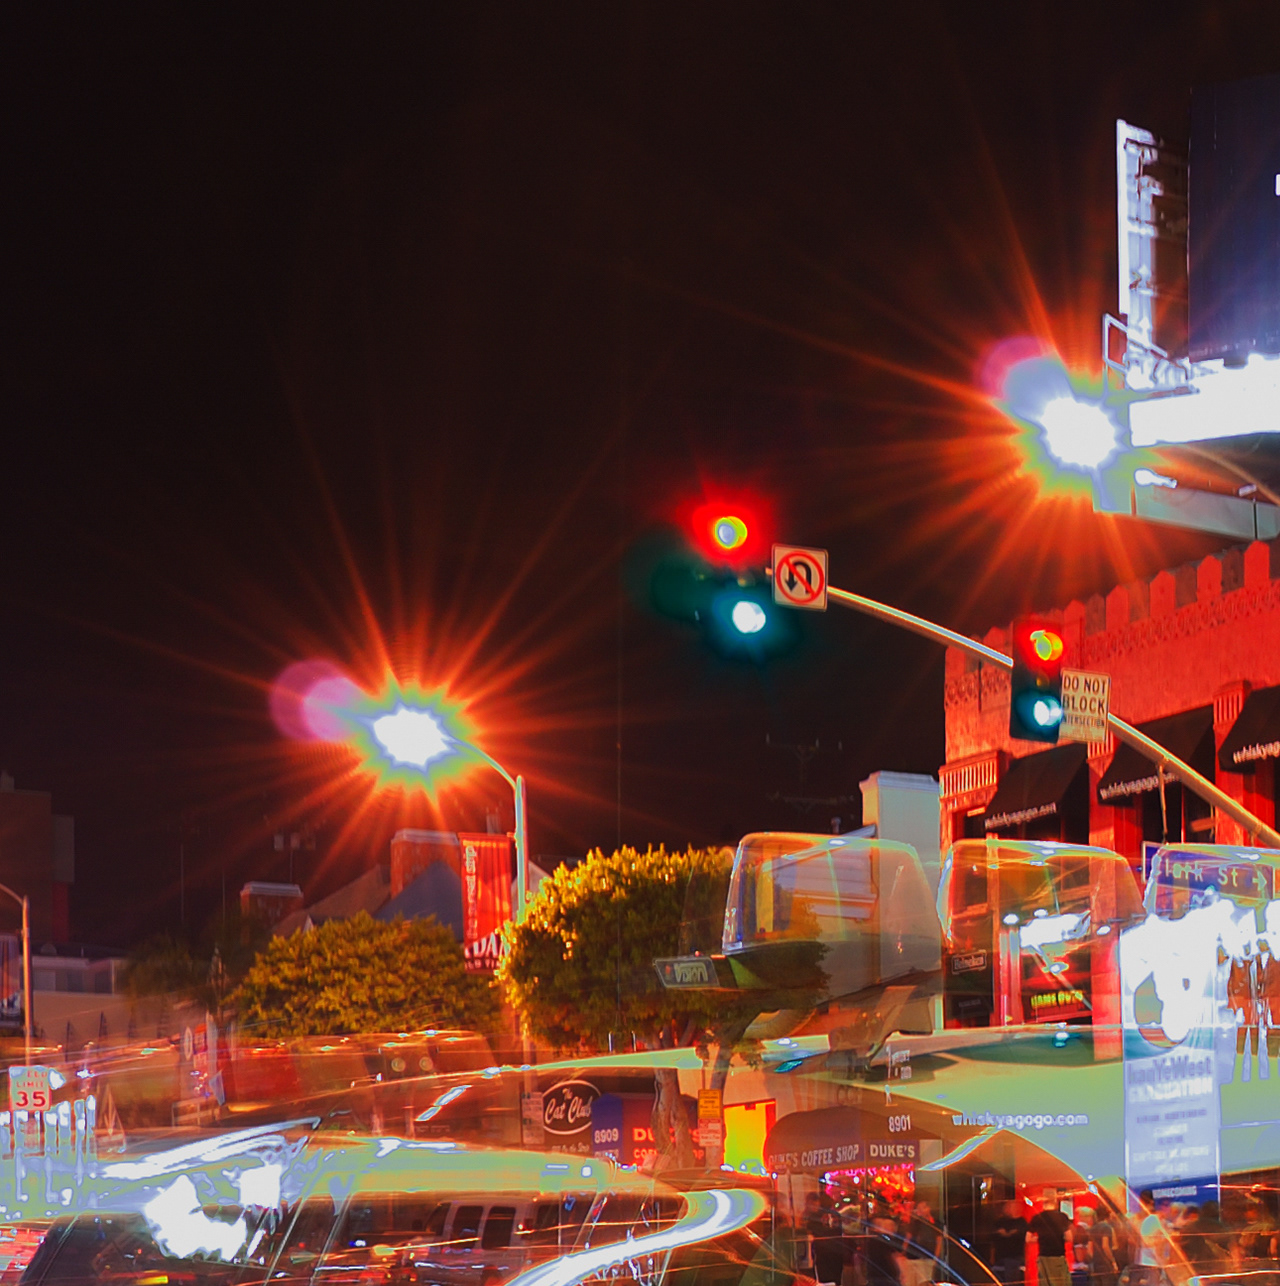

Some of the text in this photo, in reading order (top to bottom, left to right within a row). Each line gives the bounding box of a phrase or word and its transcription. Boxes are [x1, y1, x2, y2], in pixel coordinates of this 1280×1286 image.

[1063, 674, 1106, 696] DO NOT
[1062, 694, 1105, 716] BLOCK
[1153, 858, 1238, 887] lark St
[15, 1091, 46, 1107] 35
[544, 1099, 565, 1124] Cat
[952, 1111, 1089, 1130] whiskyagogo.com
[888, 1115, 911, 1133] 8901
[594, 1128, 619, 1144] 8909
[801, 1148, 833, 1166] COFFEE
[836, 1144, 859, 1163] SHOP
[869, 1144, 915, 1158] DUKE'S
